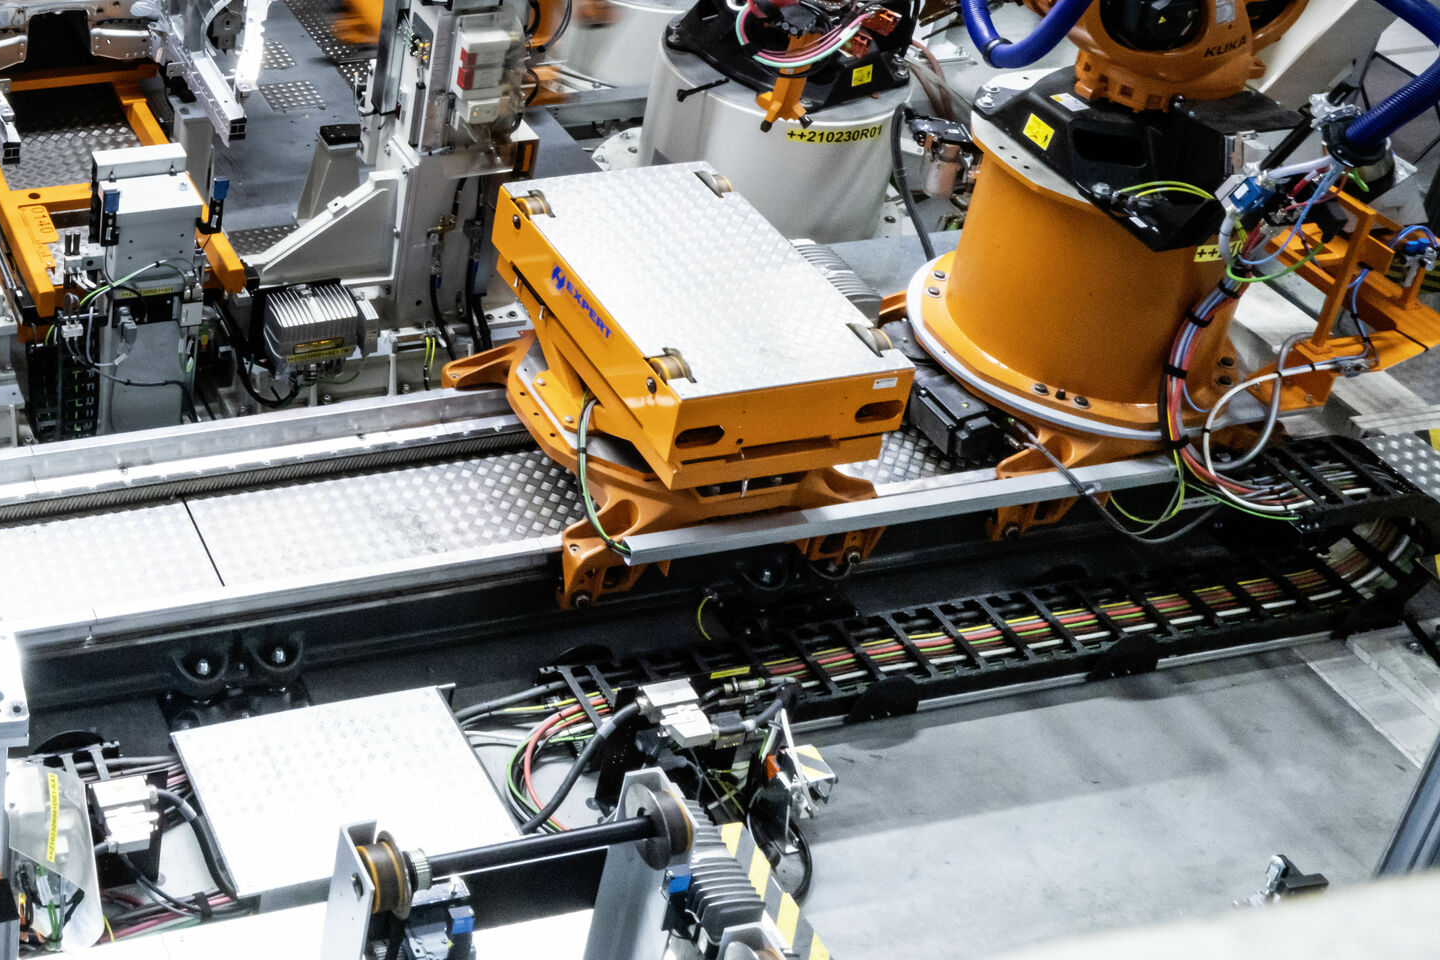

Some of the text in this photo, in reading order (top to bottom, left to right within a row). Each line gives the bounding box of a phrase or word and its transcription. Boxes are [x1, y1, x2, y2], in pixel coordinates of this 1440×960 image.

[1204, 35, 1246, 57] KUKA
[787, 125, 882, 143] ++210230R01
[566, 280, 611, 338] EXPERT
